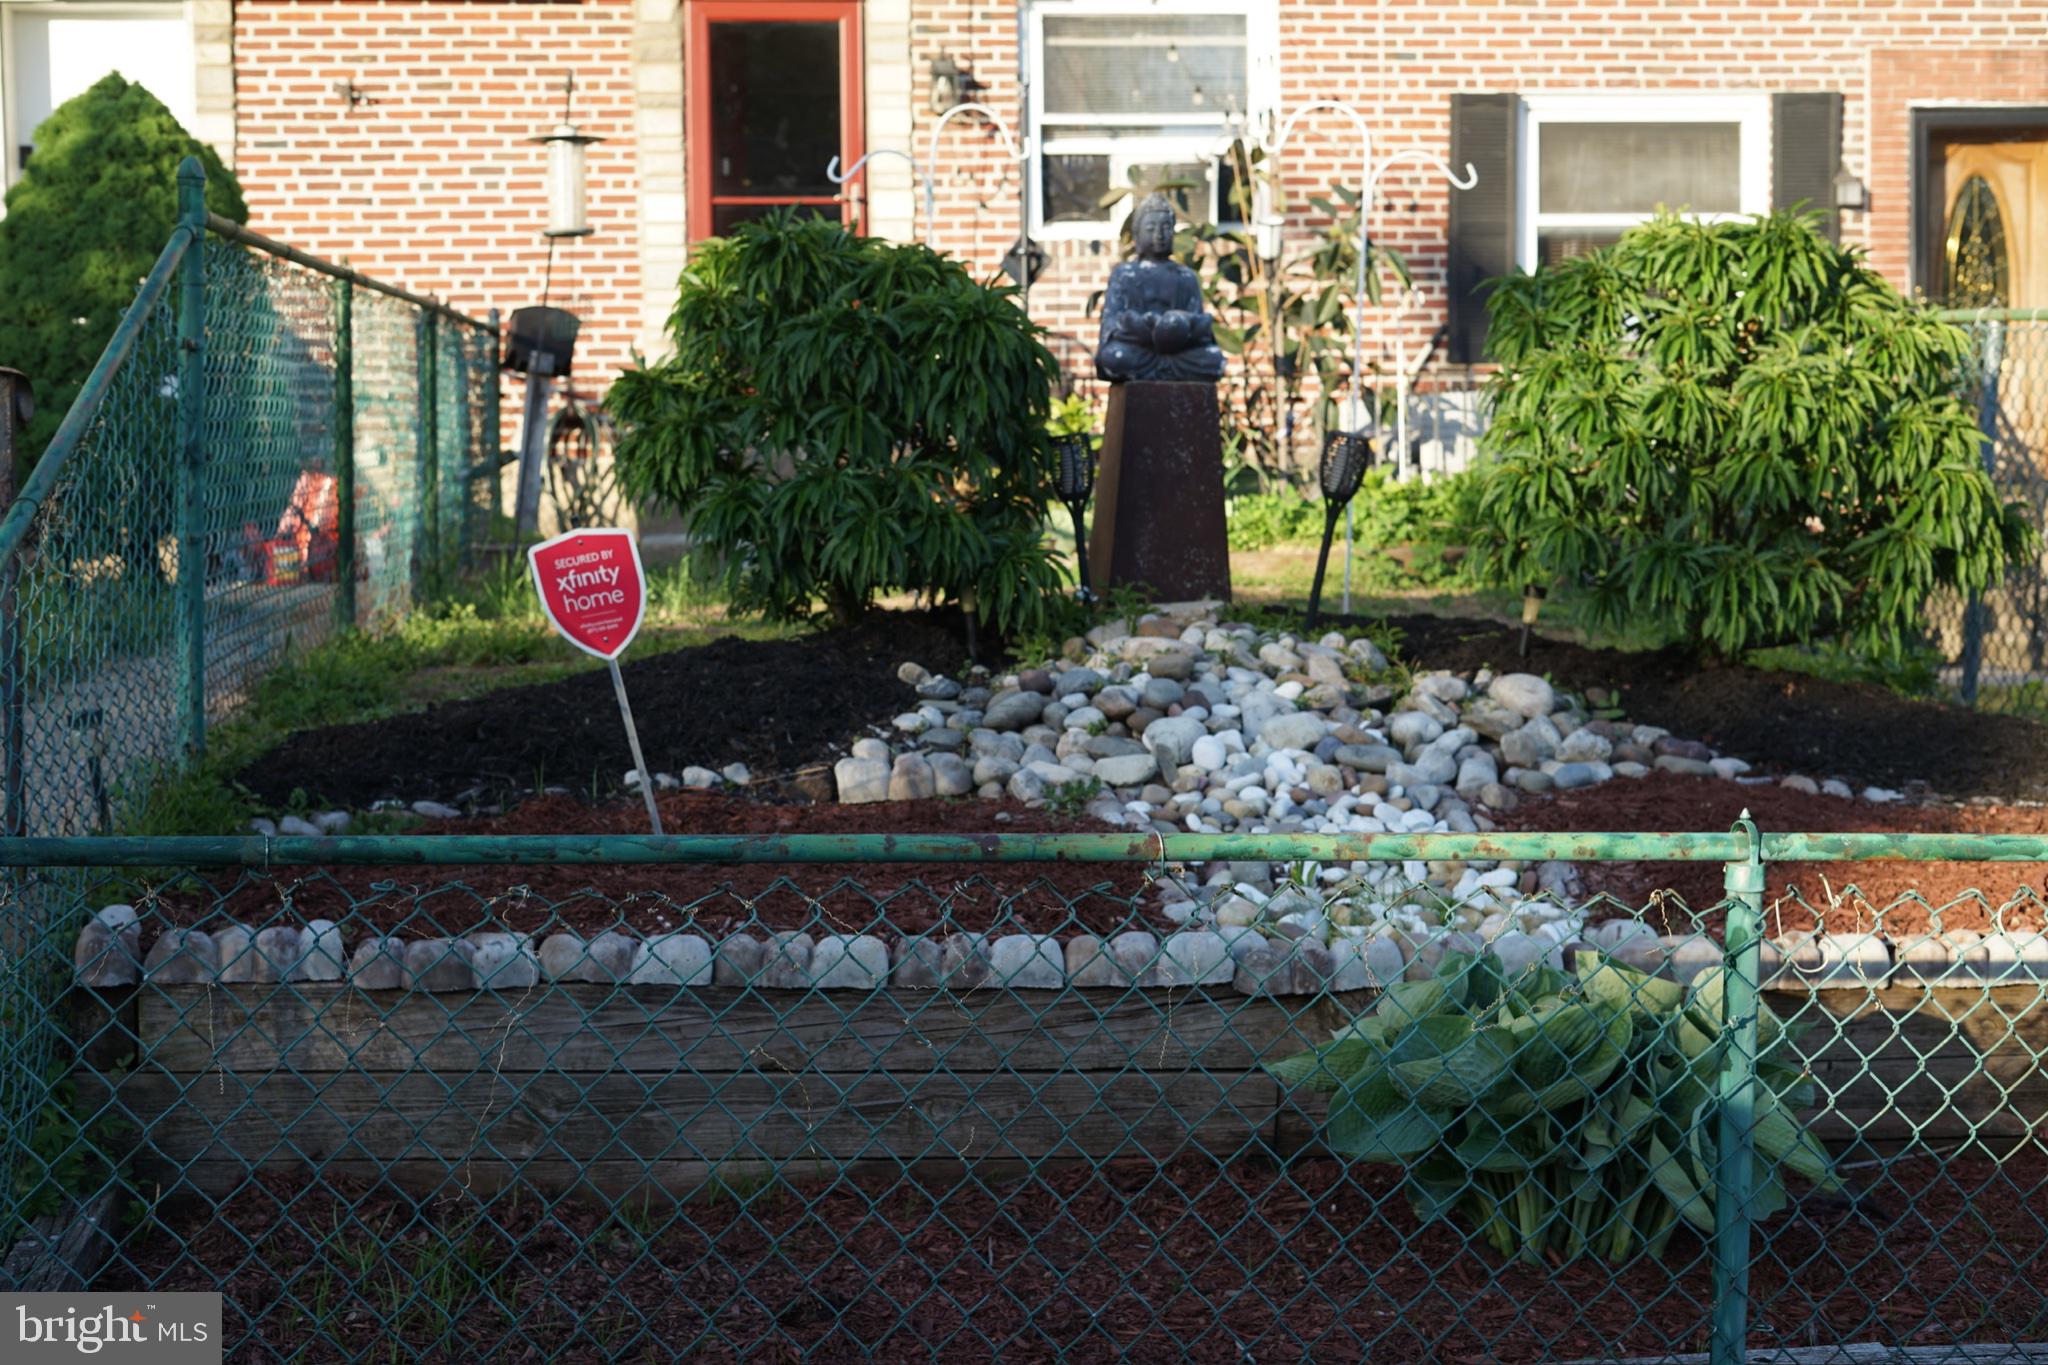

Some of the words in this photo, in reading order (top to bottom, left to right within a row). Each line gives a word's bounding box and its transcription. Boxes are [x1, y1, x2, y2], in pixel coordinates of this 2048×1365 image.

[555, 552, 599, 569] SECURED
[600, 549, 613, 560] BY
[556, 564, 620, 593] xfinity
[563, 589, 624, 612] home
